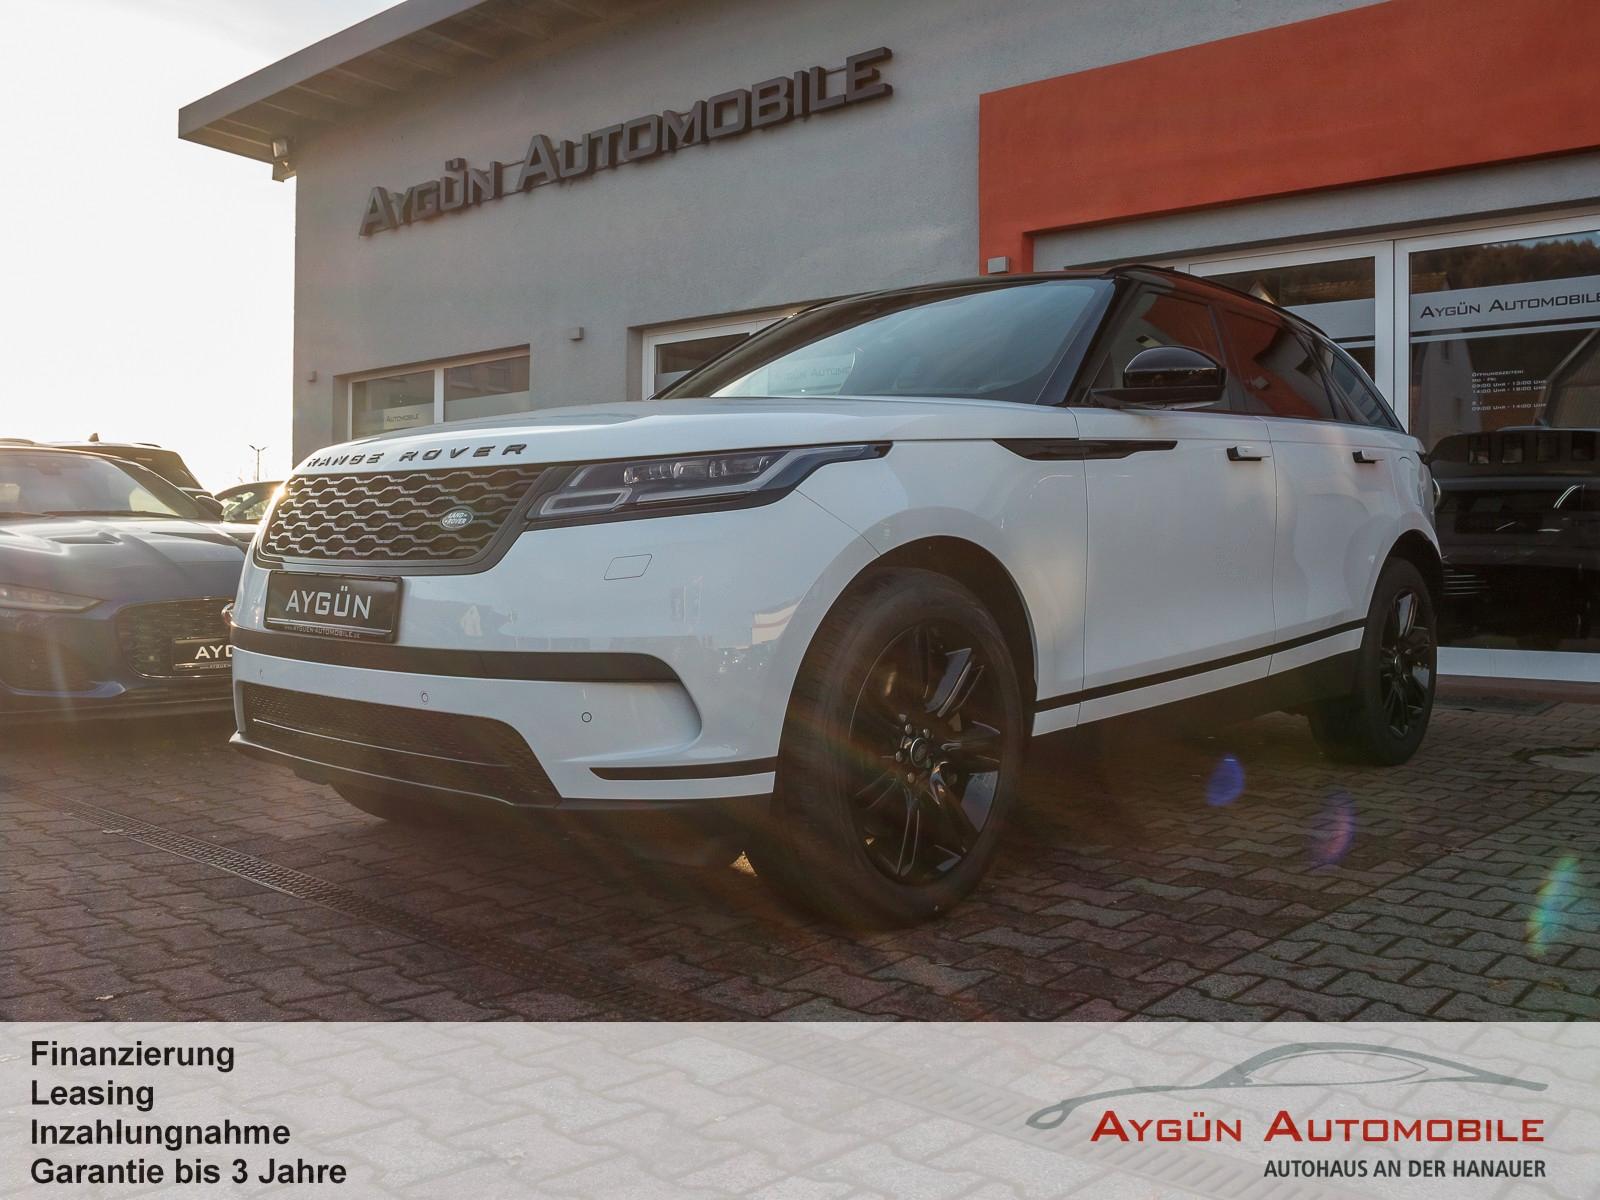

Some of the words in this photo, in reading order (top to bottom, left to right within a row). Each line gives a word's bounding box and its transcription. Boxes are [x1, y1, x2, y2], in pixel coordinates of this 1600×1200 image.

[359, 157, 503, 236] AYGÜN
[515, 46, 894, 193] AUTOMOBILE
[1420, 301, 1481, 319] AYGÜN
[307, 452, 384, 468] RANGE
[399, 443, 528, 463] ROVER
[285, 585, 372, 619] AYGÜN
